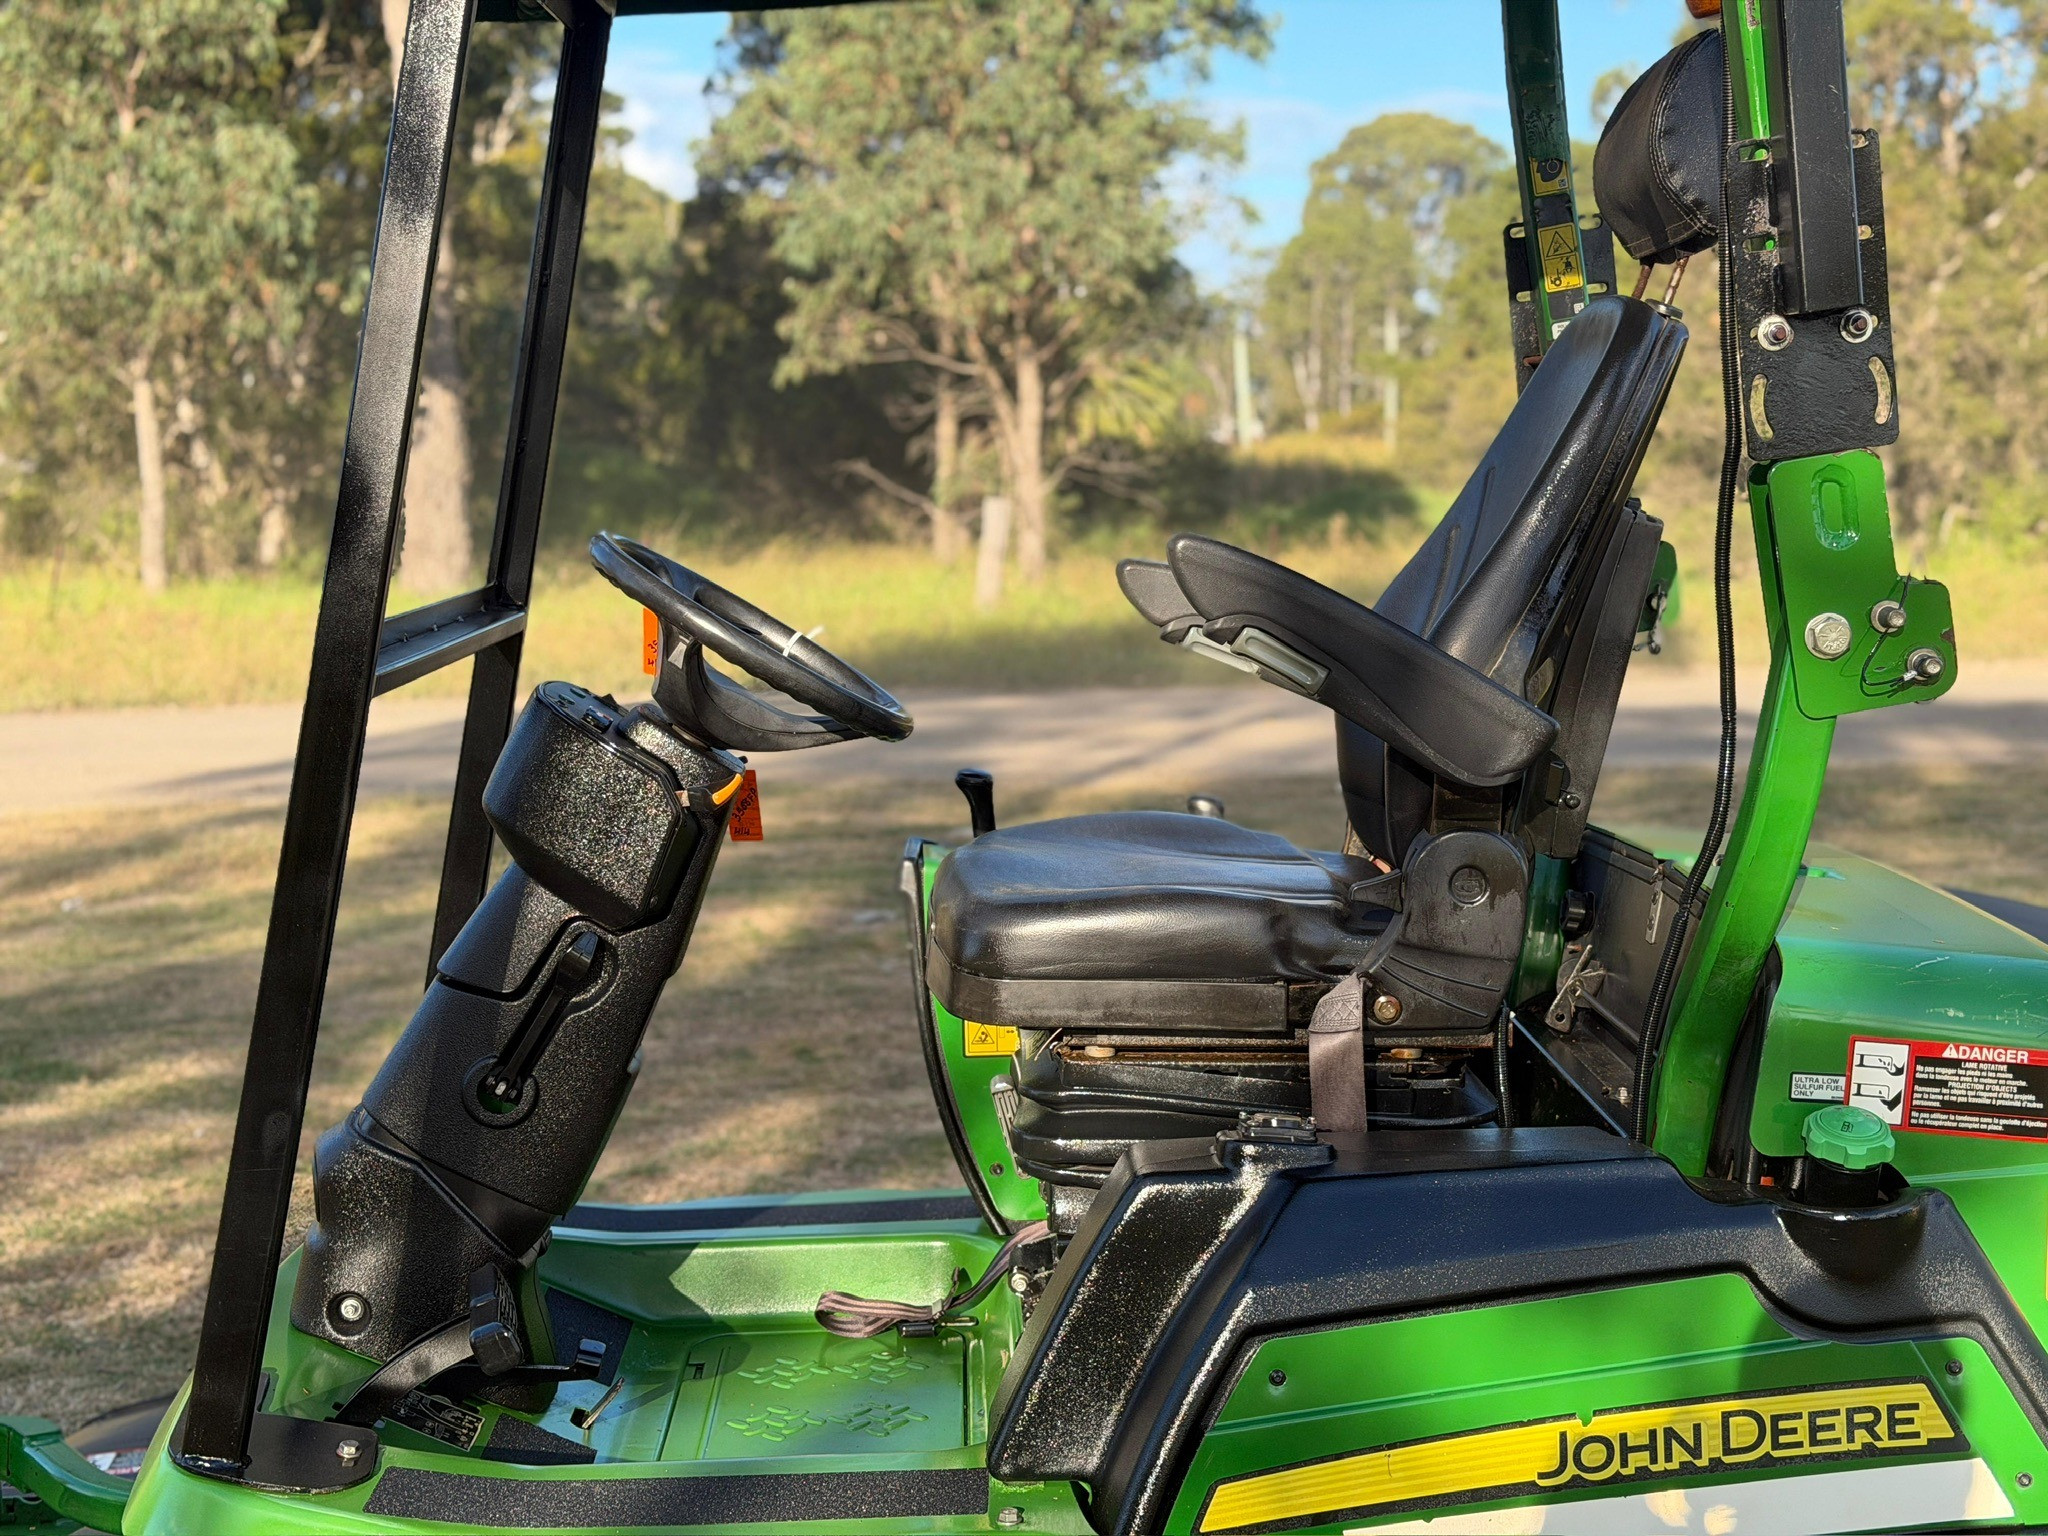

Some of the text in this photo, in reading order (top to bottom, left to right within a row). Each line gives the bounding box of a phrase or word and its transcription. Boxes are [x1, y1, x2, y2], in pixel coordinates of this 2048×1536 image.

[1958, 1046, 2028, 1064] DANGER
[1979, 1063, 2008, 1072] ROTATIVE
[1948, 1081, 1984, 1090] PROJECTION
[1537, 1402, 1922, 1481] JOHN DEERE
